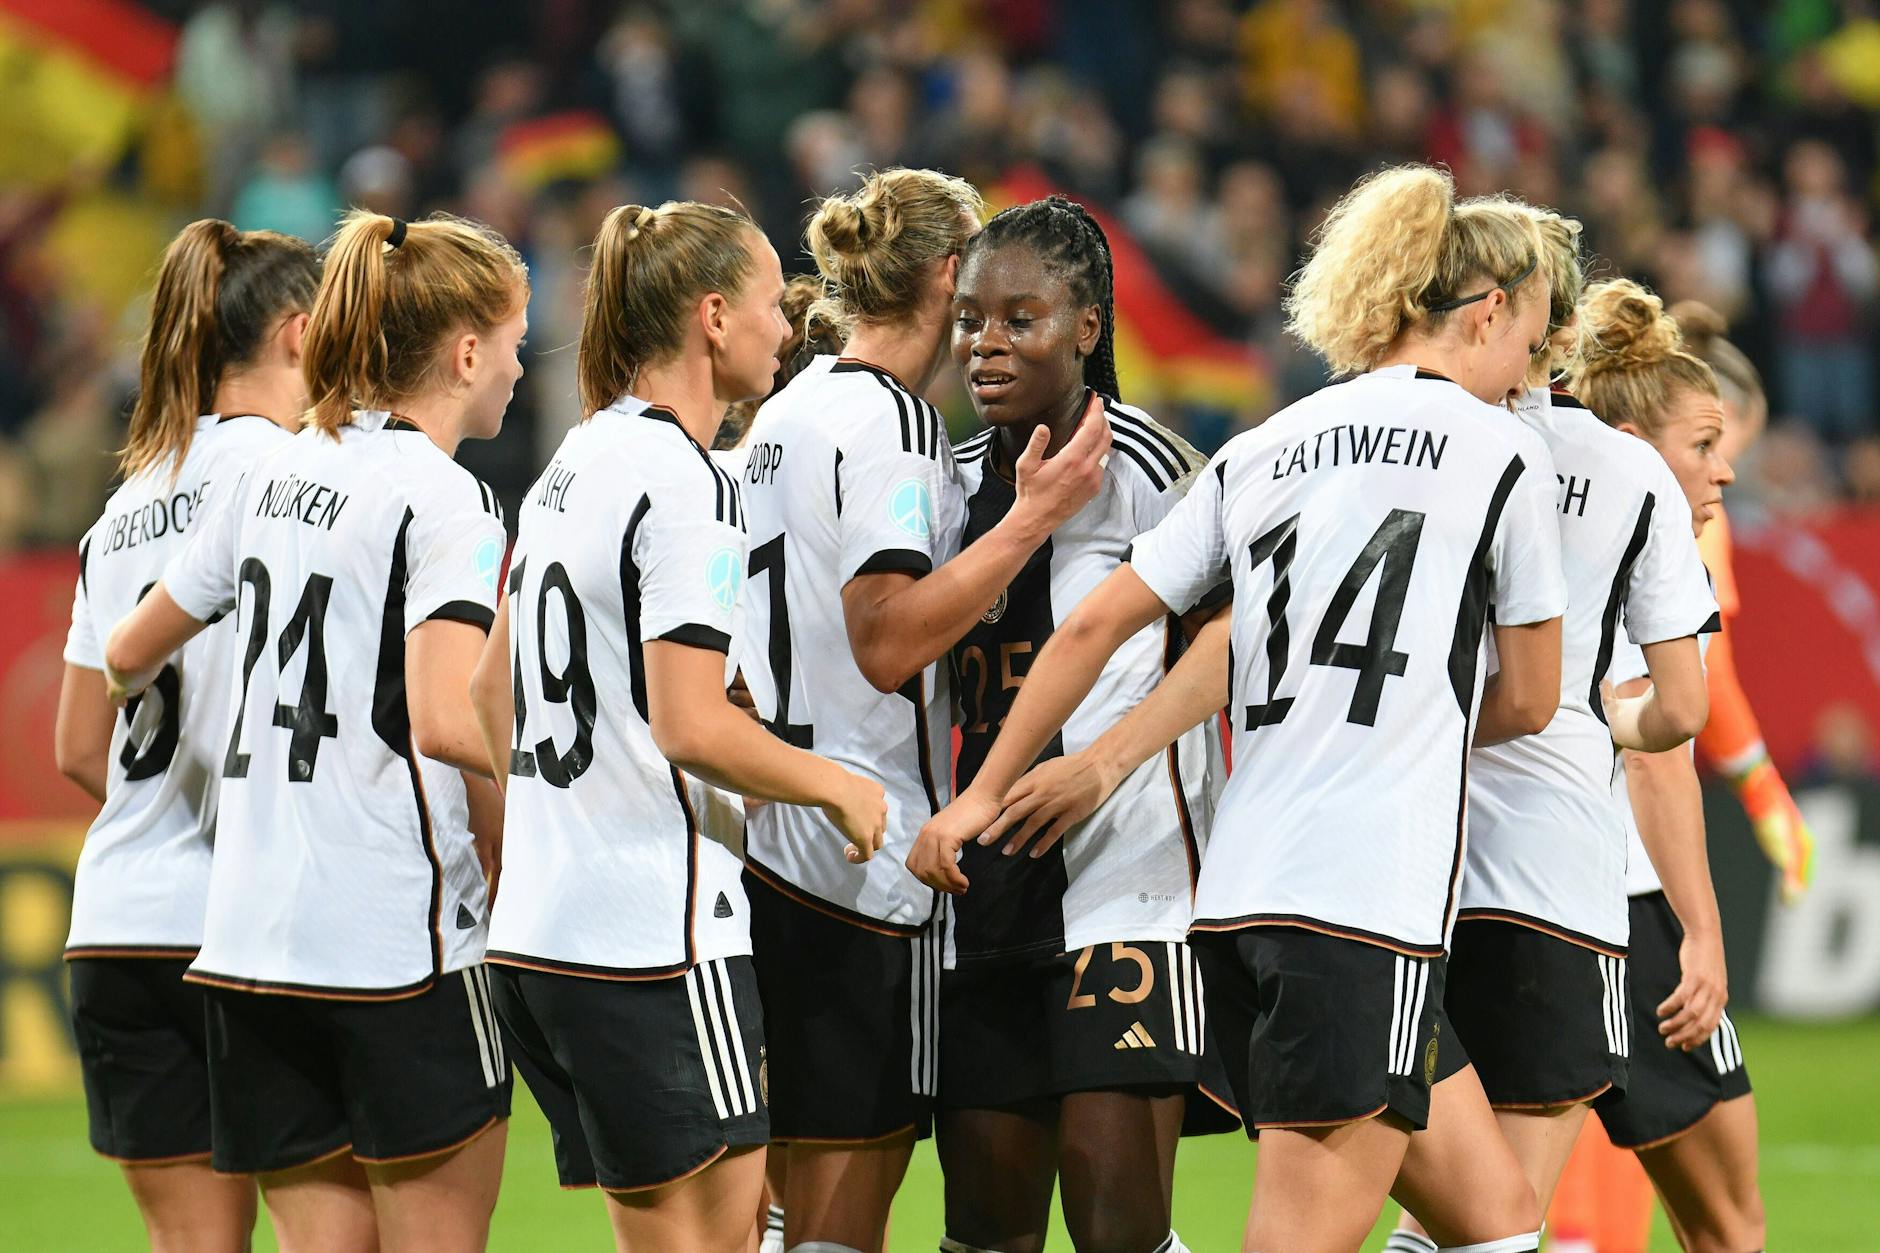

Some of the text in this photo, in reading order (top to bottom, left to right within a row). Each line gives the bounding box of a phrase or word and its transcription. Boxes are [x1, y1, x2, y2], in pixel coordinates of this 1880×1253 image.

[537, 459, 576, 513] ÜHL
[743, 442, 783, 485] POPP
[1272, 424, 1449, 480] LATTWEIN
[256, 473, 349, 531] NÜSKEN
[1245, 508, 1427, 733] 14
[222, 556, 338, 782] 24
[508, 553, 598, 789] 19
[960, 640, 1033, 734] 25
[1056, 942, 1155, 1011] 25
